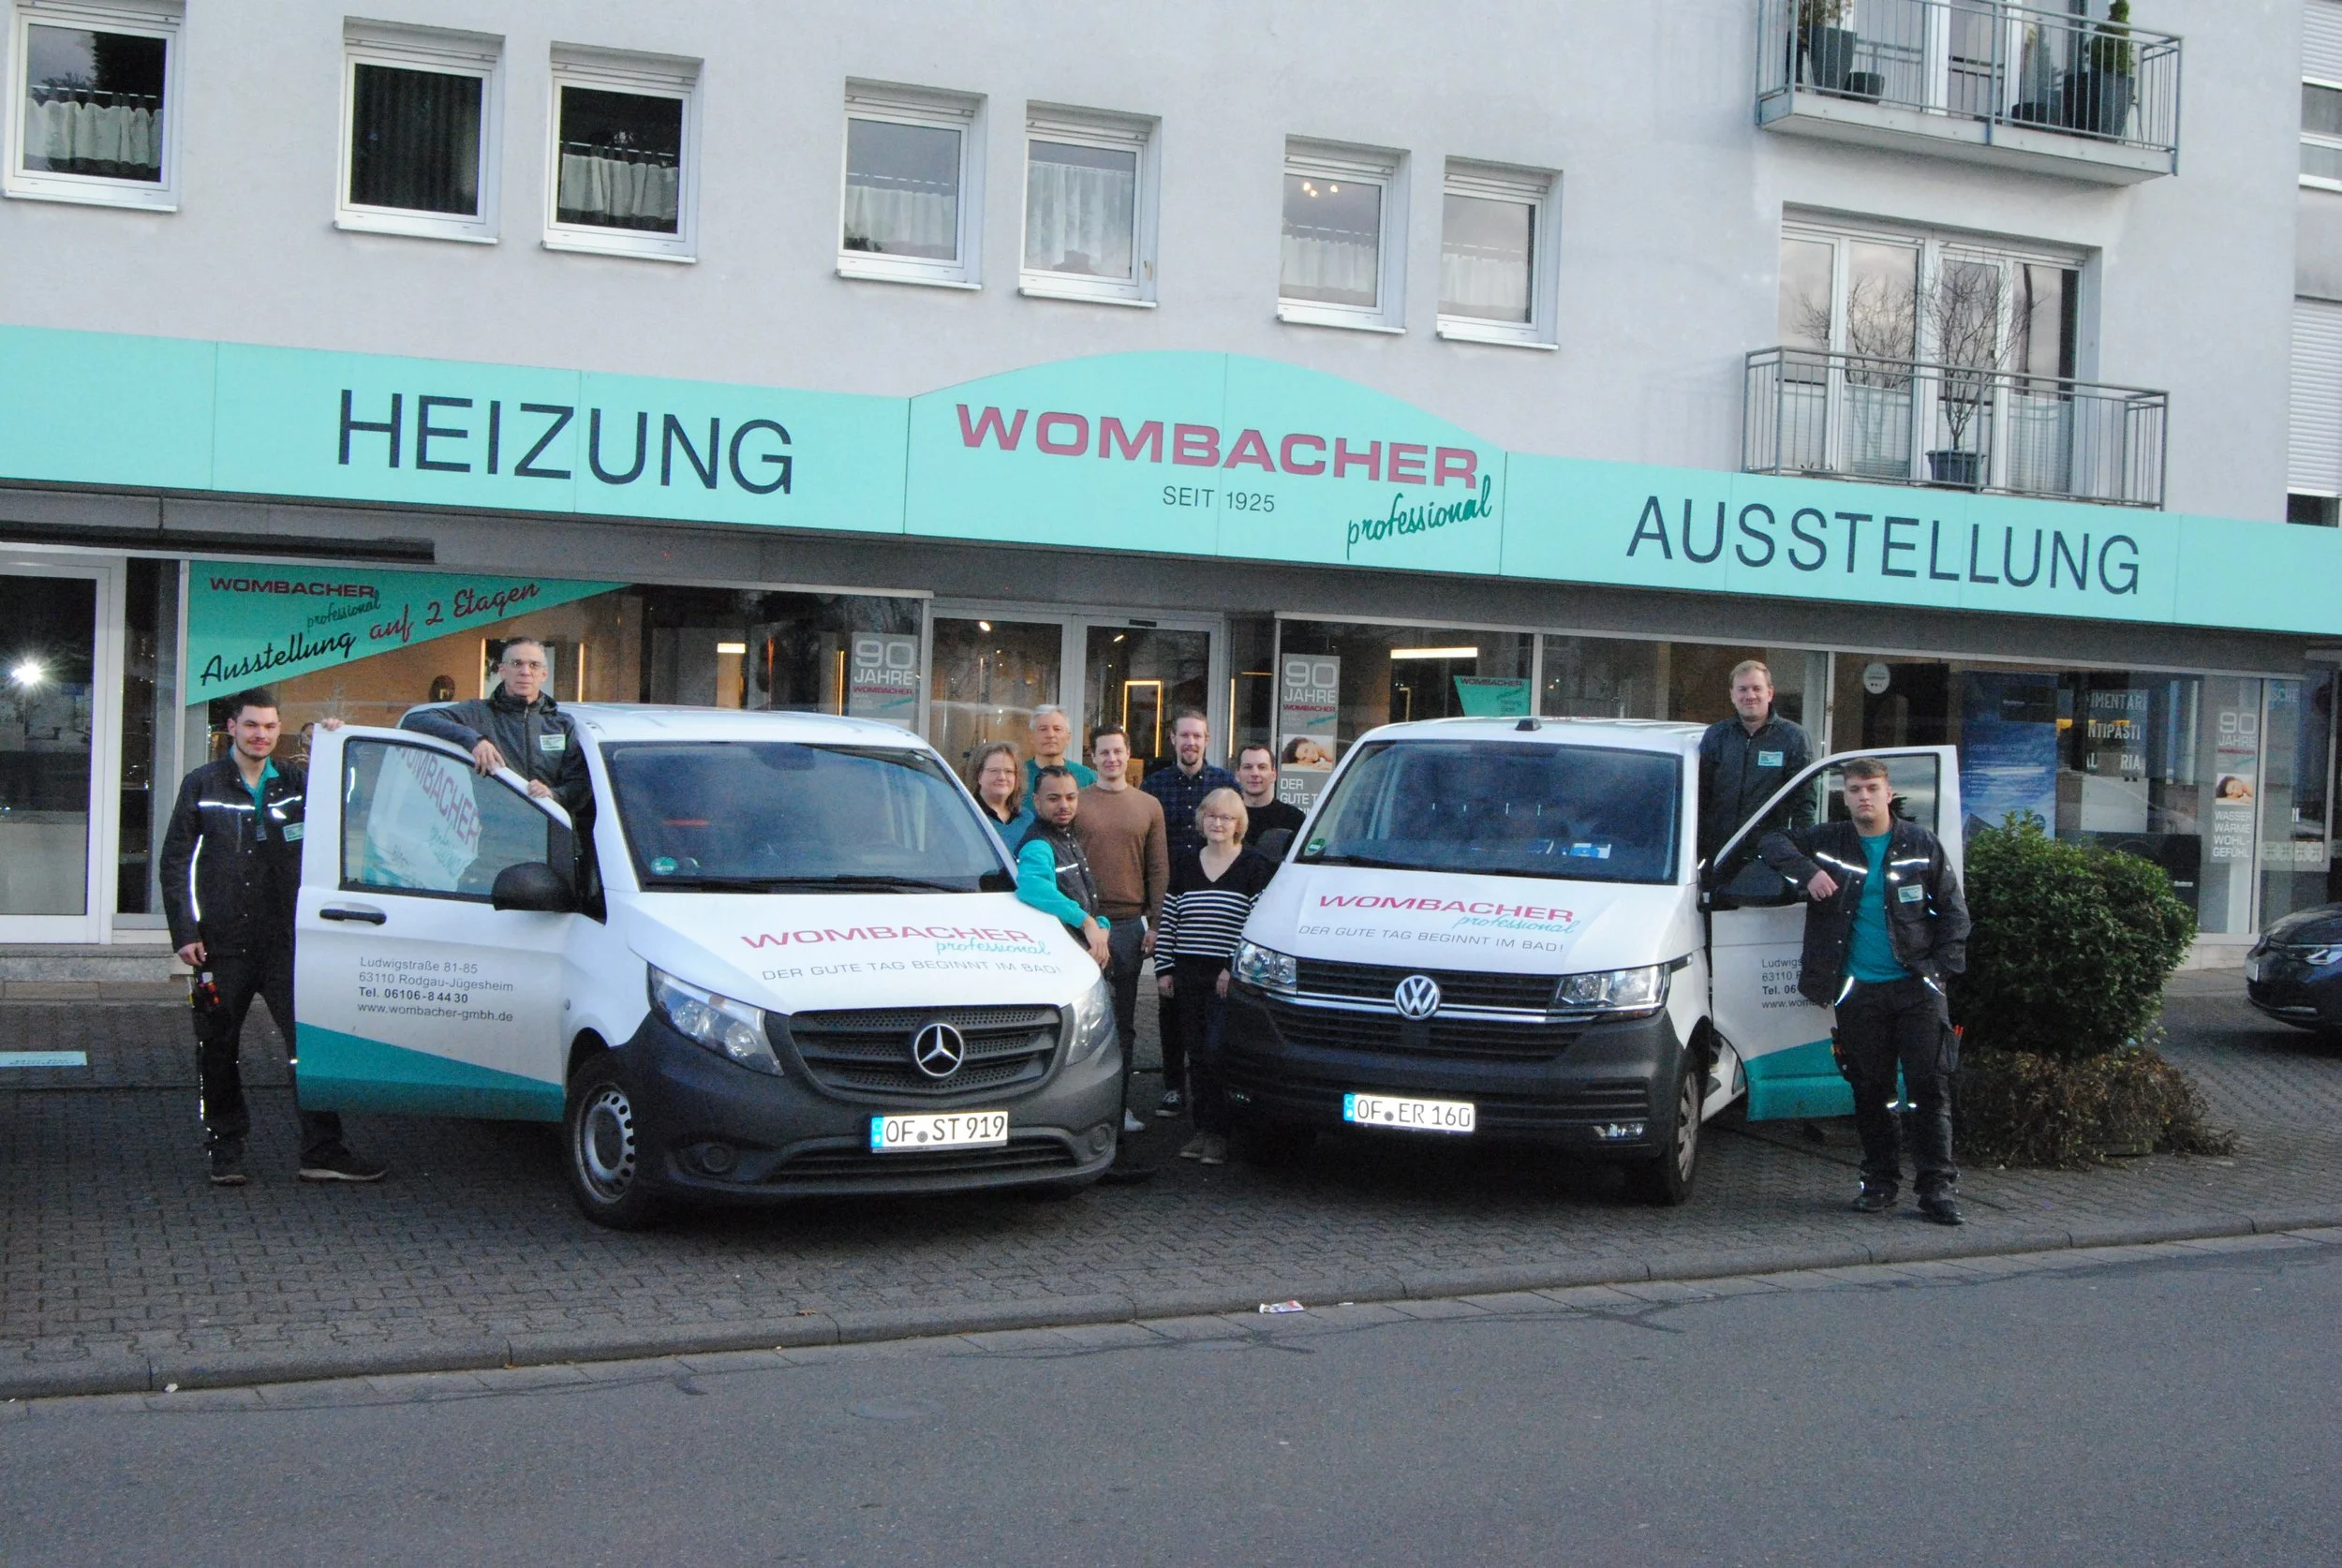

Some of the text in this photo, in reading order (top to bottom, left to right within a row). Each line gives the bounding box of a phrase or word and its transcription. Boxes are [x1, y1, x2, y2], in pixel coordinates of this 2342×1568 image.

[338, 389, 793, 495] HEIZUNG
[956, 403, 1478, 489] WOMBACHER
[1163, 485, 1275, 513] SEIT 1925
[1346, 474, 1491, 560] professional
[1626, 495, 2141, 595] AUSSTELLUNG
[209, 577, 375, 599] WOMBACHER
[306, 590, 381, 633] professional
[200, 582, 541, 687] Ausstellung auf 2 Etagen
[854, 639, 915, 670] 90
[853, 667, 914, 686] JAHRE
[1284, 660, 1338, 688] 90
[1283, 688, 1337, 703] JAHRE
[2087, 722, 2142, 741] NTIPASTI
[2218, 712, 2257, 735] 90
[2217, 734, 2257, 747] JAHRE
[1280, 777, 1304, 790] DER
[1280, 792, 1310, 805] GUTE
[2214, 810, 2251, 821] WASSER
[2214, 822, 2251, 834] WÄRME
[2214, 835, 2251, 846] WOHL-
[2213, 845, 2250, 858] GEFÜHL
[1319, 895, 1575, 923] WOMBACHER
[1452, 913, 1581, 935] professional
[739, 925, 1036, 950] WOMBACHER
[936, 939, 1052, 956] professional
[1298, 925, 1564, 953] DER GUTE TAG BEGINNT IM BAD!
[360, 956, 479, 974] Ludwigstraße 81-85
[762, 960, 1062, 981] DER GUTE TAG BEGINNT IM BAD!
[1762, 957, 1802, 969] Ludwigs
[359, 971, 513, 992] 63110 Rodgau-Jügesheim
[1762, 971, 1793, 982] 63110
[359, 986, 380, 998] Tel.
[1762, 985, 1781, 996] Tel.
[358, 1002, 513, 1022] www.wombacher-gmbh.de
[1357, 1099, 1471, 1127] OF ER 160
[885, 1115, 1005, 1143] OF ST 919
